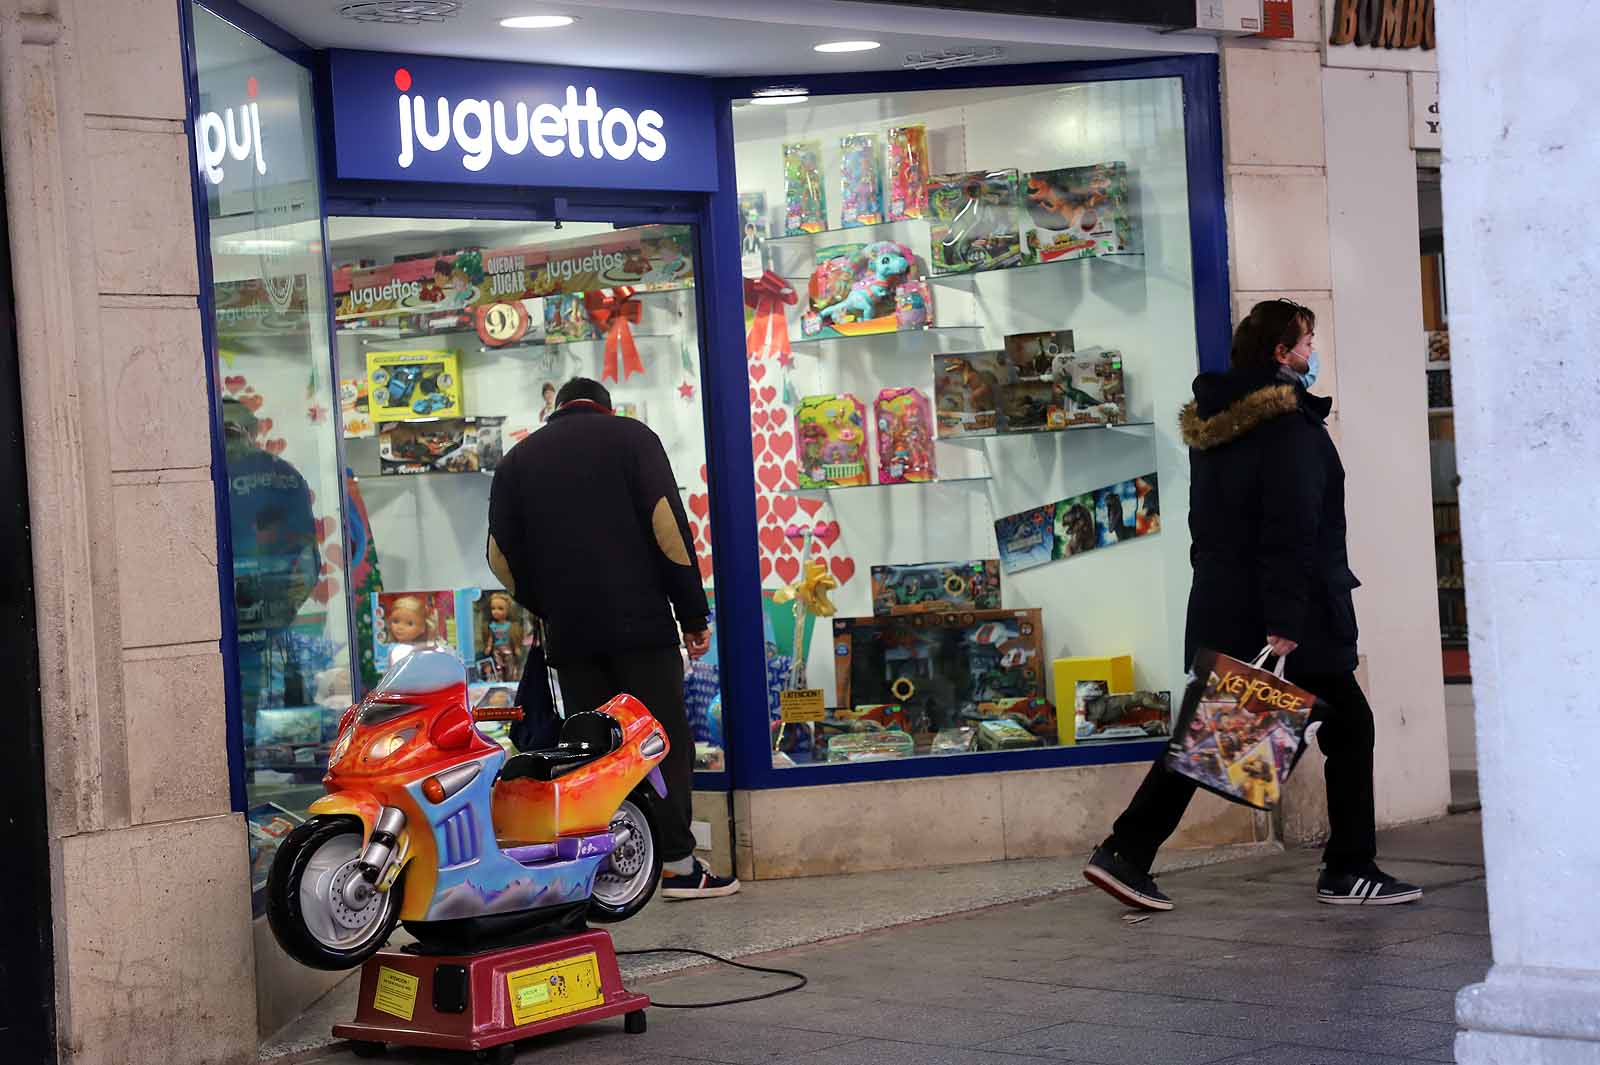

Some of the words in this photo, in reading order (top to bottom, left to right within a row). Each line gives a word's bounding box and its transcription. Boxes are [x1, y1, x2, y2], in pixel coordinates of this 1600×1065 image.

[394, 67, 666, 171] juguettos
[545, 249, 624, 282] juguettos
[350, 278, 420, 309] juguettos
[490, 271, 526, 296] JUGAR
[1216, 671, 1304, 713] KEYFORGE
